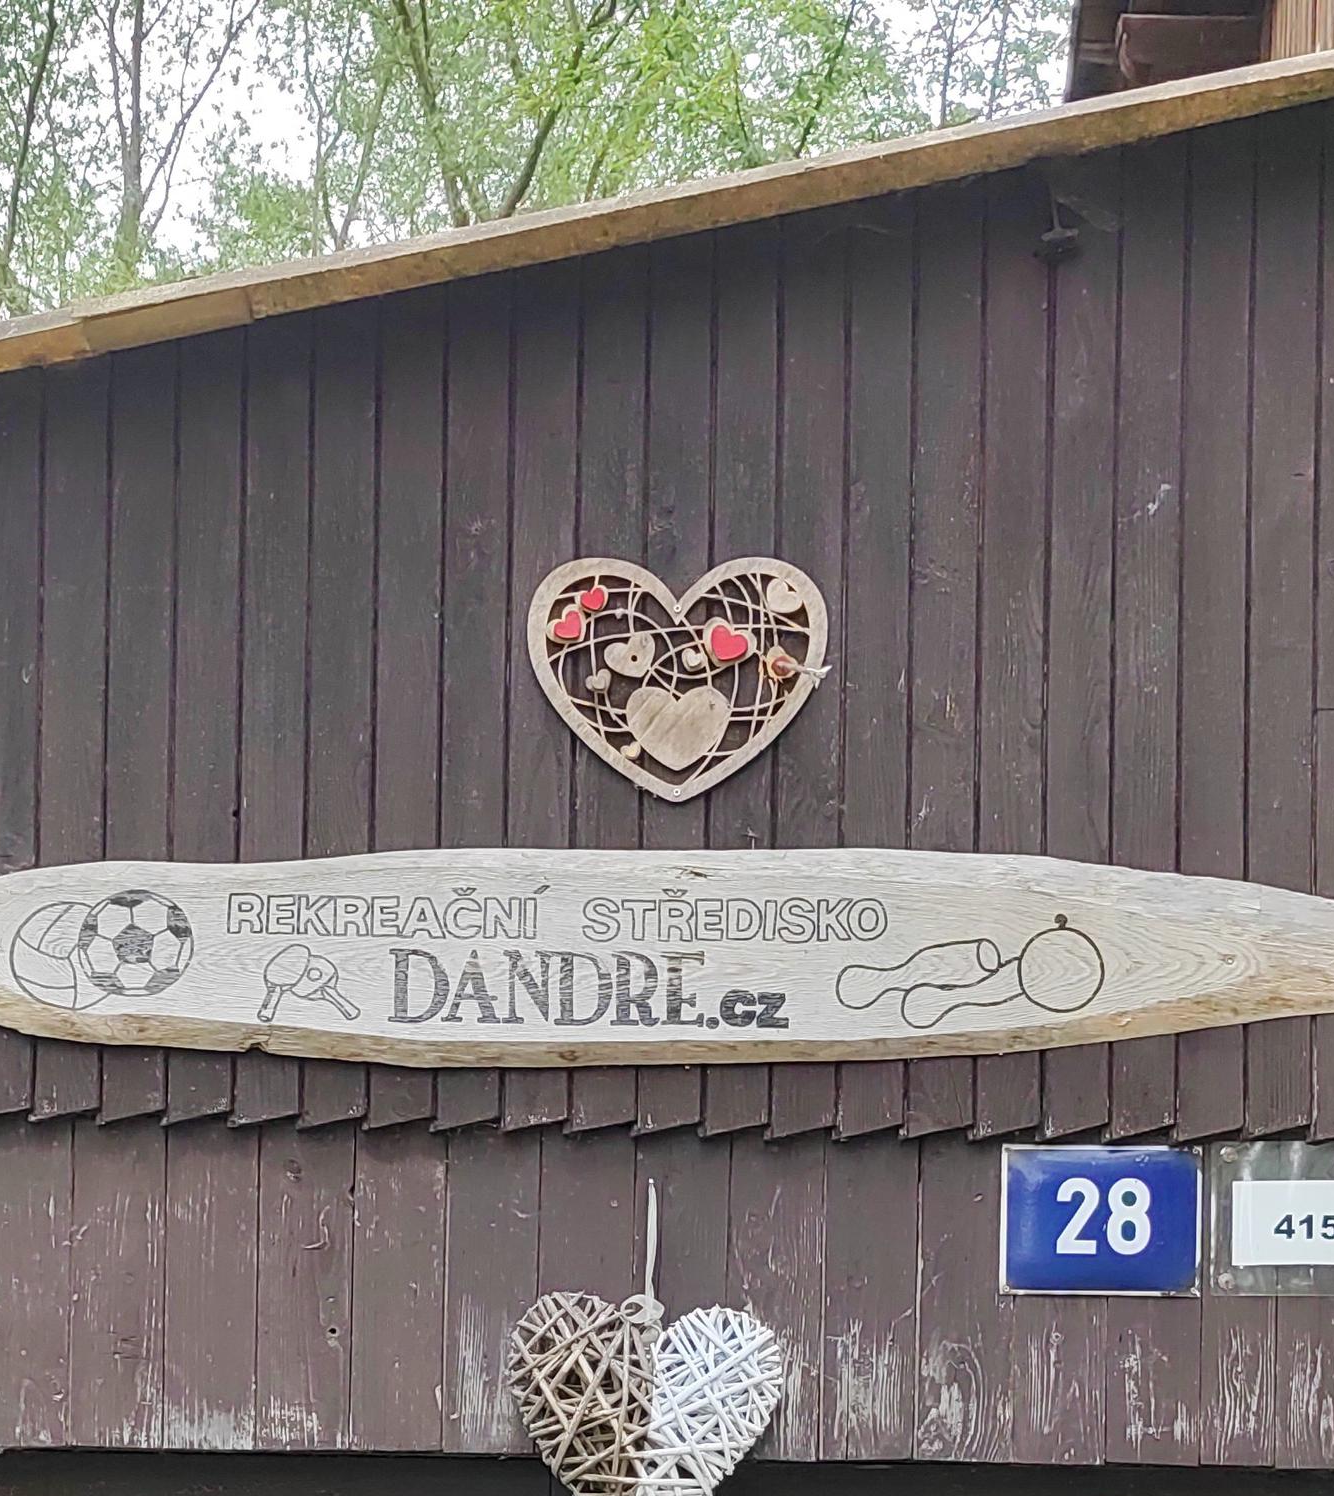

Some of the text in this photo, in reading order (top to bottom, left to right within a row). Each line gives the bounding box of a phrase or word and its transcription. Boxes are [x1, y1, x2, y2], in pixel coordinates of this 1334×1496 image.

[227, 885, 888, 943] REKREAČNÍ STŘEDISKO
[388, 948, 789, 1029] DANDRE.cz
[1056, 1177, 1151, 1255] 28
